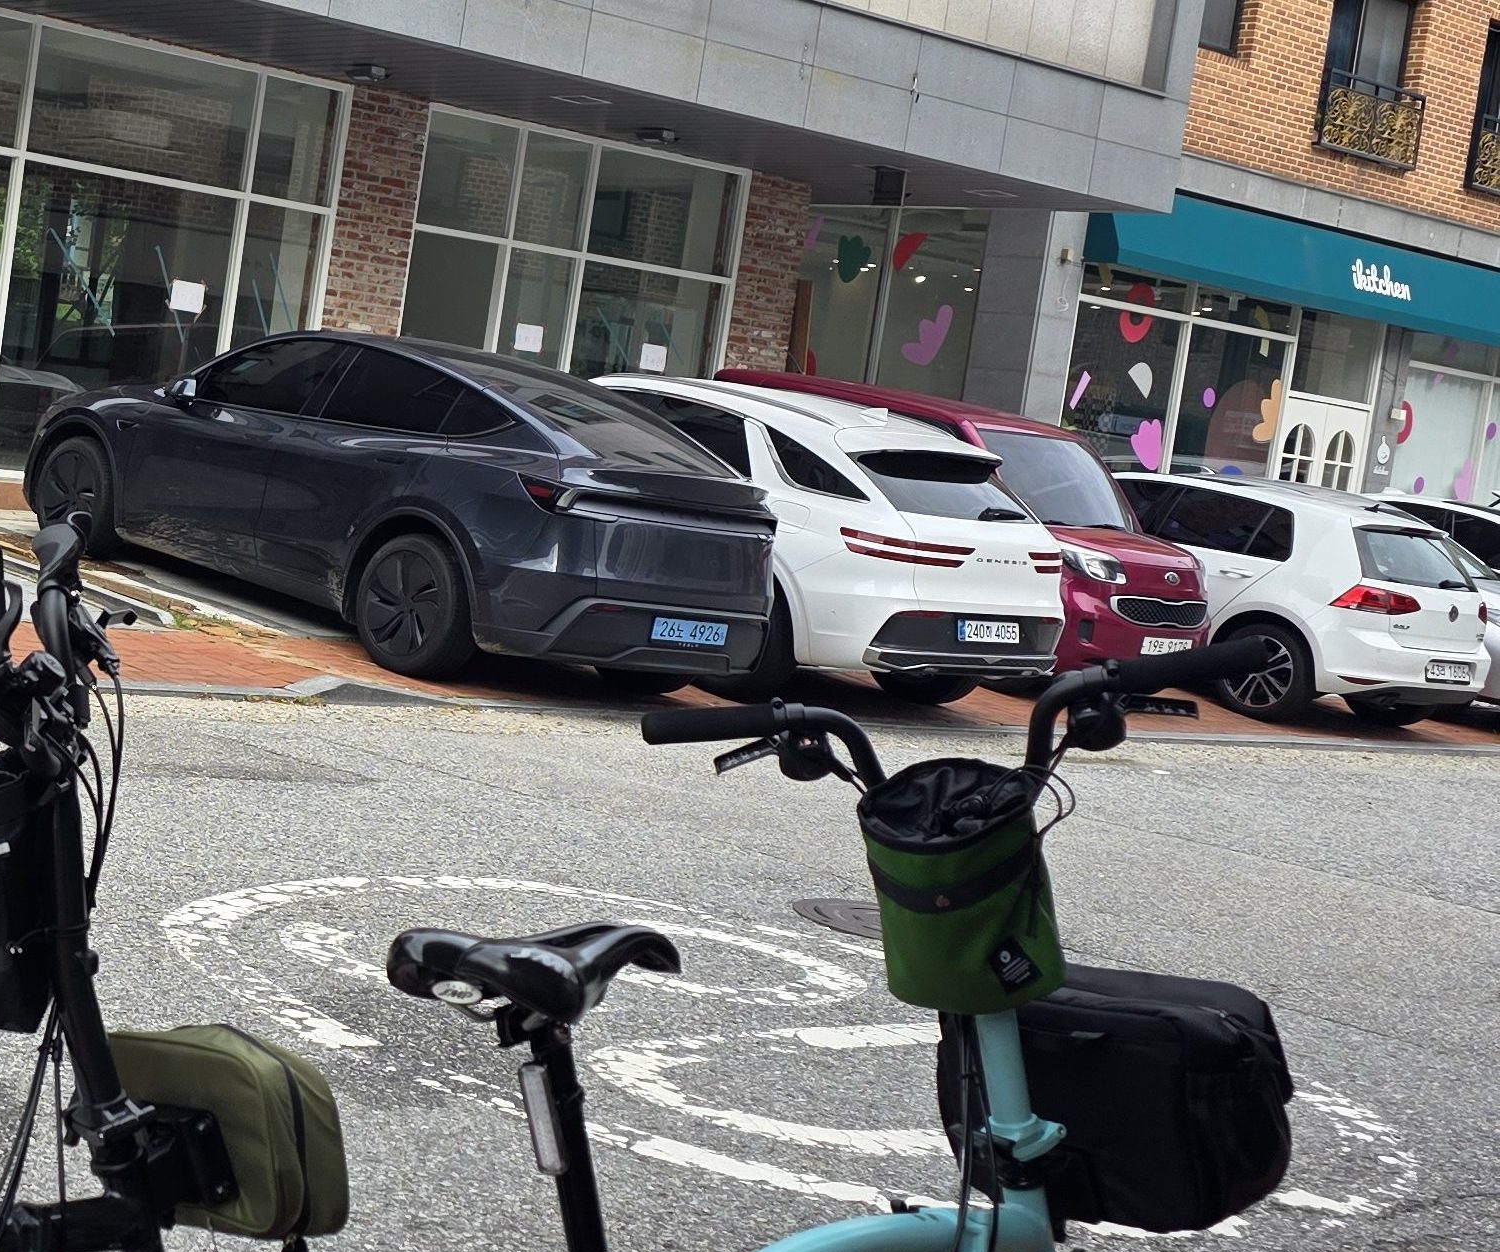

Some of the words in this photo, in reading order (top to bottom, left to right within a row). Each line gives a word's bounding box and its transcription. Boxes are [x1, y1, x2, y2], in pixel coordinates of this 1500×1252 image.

[1352, 258, 1411, 301] ikitchen
[660, 621, 684, 638] 26노
[690, 624, 720, 642] 4926
[995, 624, 1016, 640] 4055
